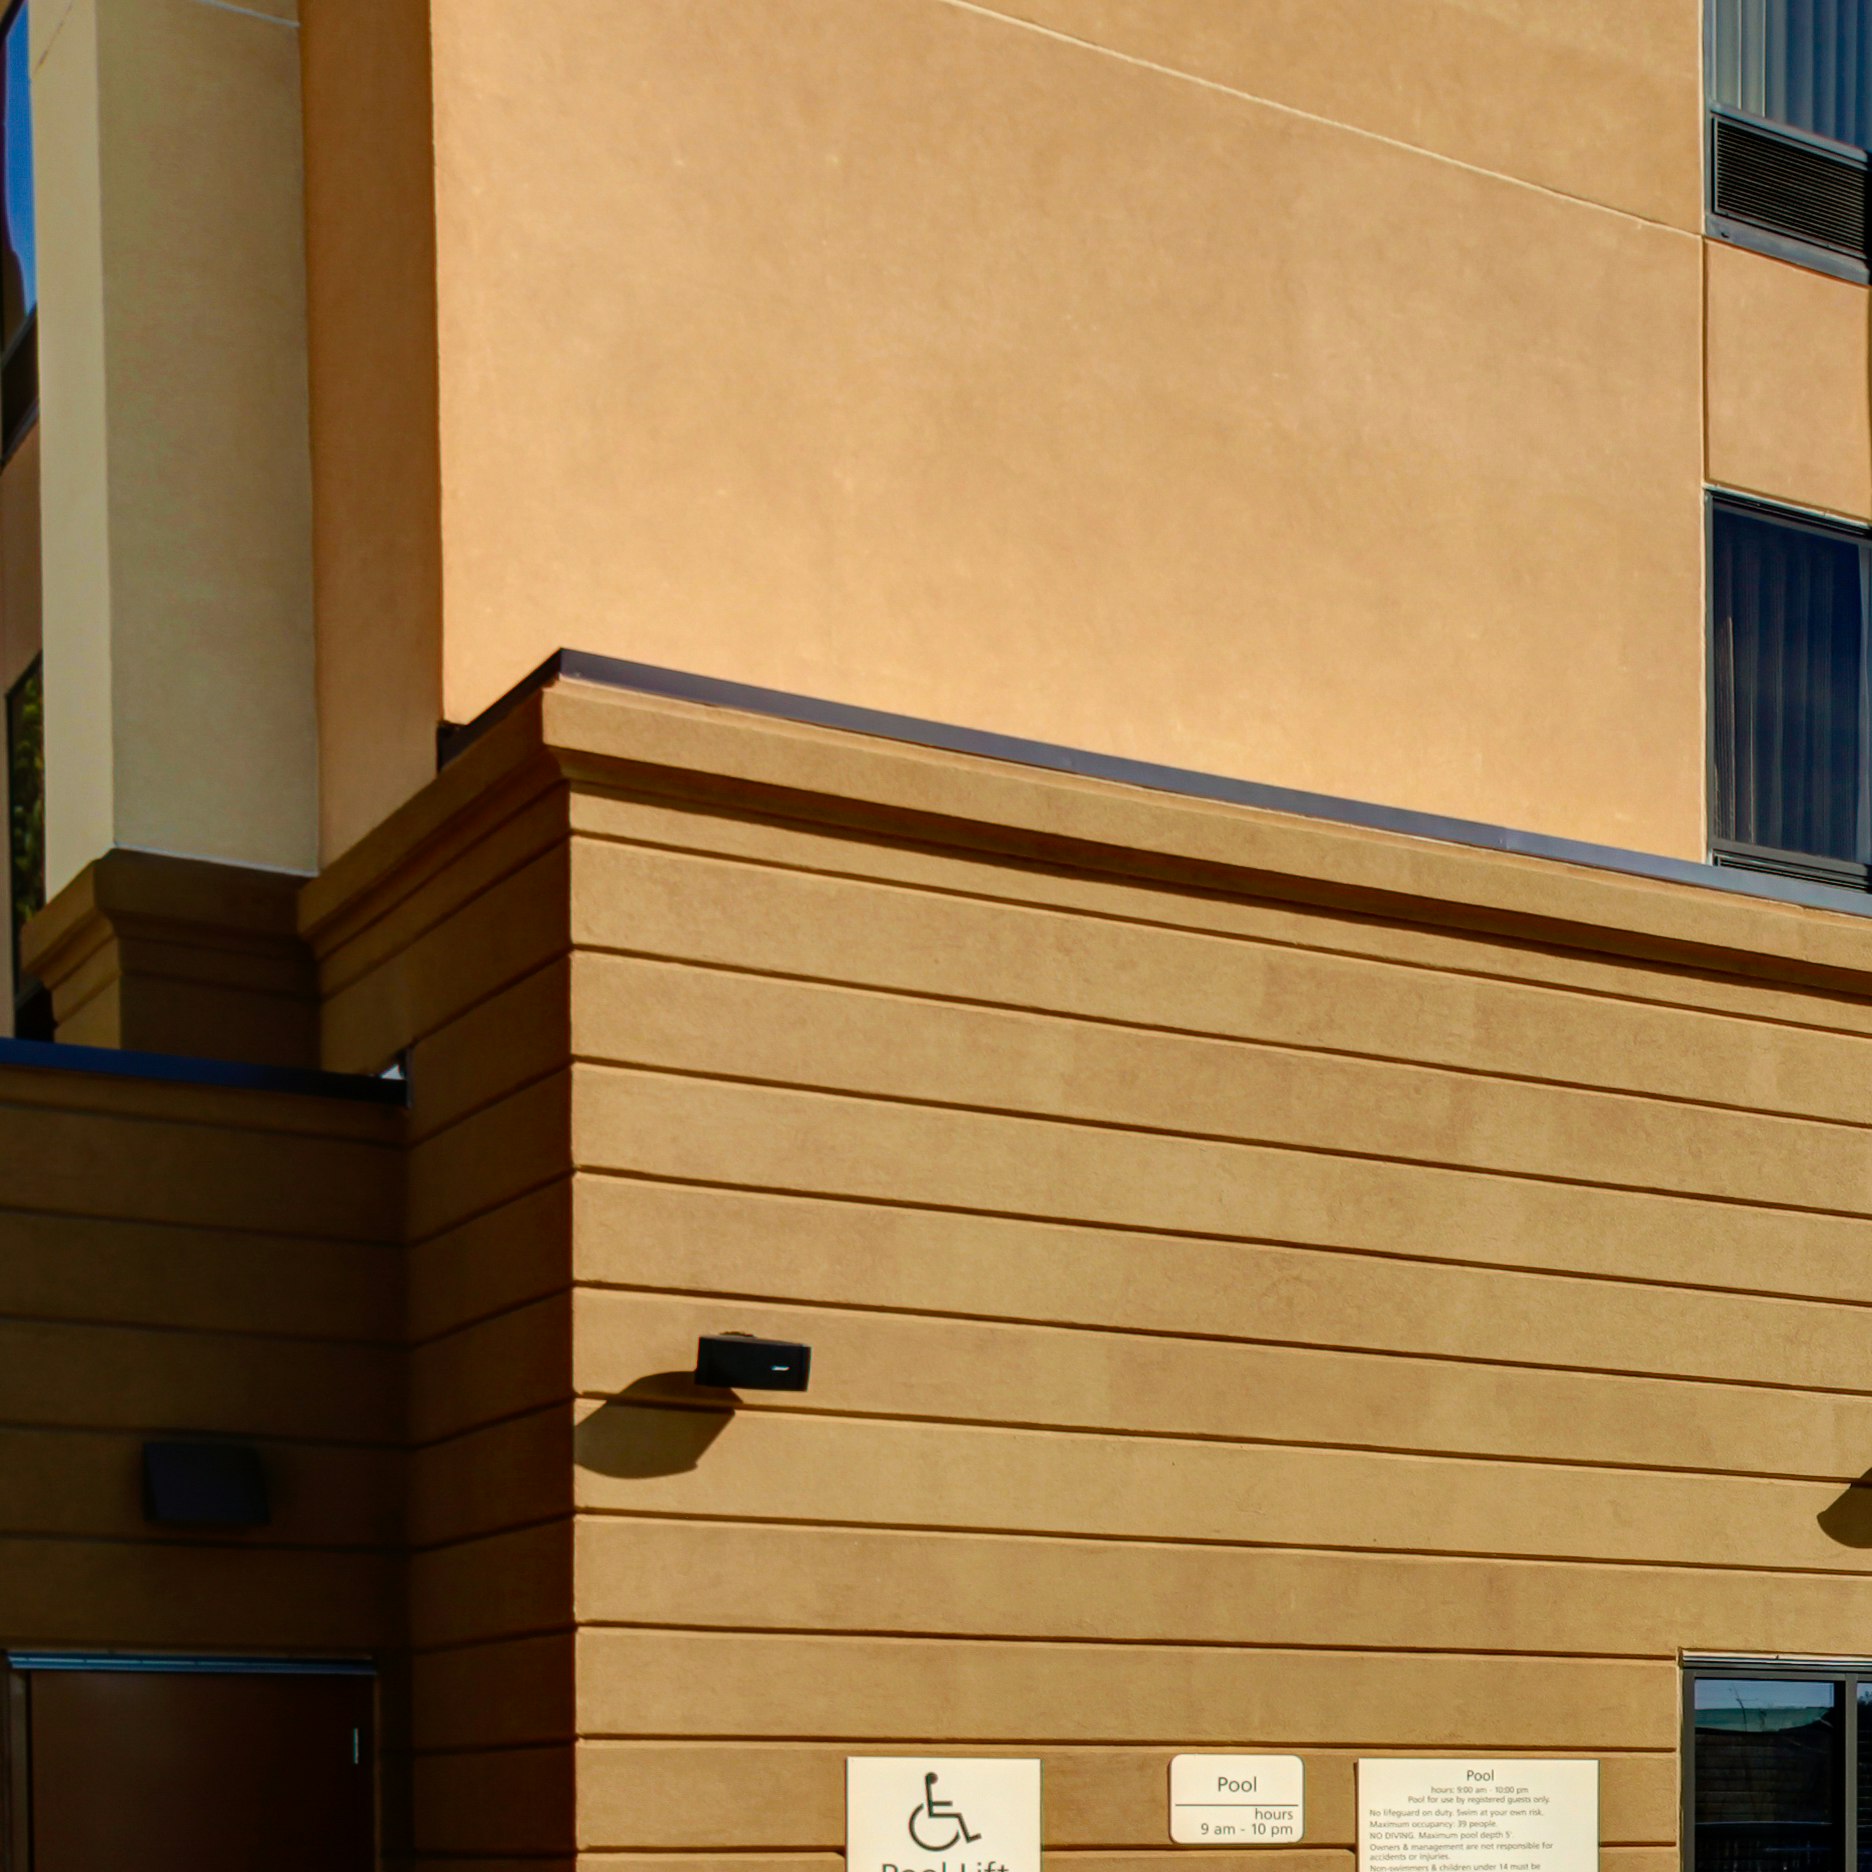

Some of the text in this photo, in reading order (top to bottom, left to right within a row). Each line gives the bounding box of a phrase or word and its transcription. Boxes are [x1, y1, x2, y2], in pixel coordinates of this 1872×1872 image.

[1467, 1770, 1494, 1781] Pool
[1217, 1775, 1257, 1793] Pool
[1456, 1796, 1465, 1804] by
[1468, 1796, 1504, 1804] registered
[1507, 1796, 1531, 1804] guests
[1254, 1807, 1293, 1821] hours
[1383, 1809, 1419, 1818] lifeguard
[1201, 1823, 1209, 1836] 9
[1214, 1826, 1236, 1836] am
[1252, 1823, 1266, 1835] 10
[1271, 1825, 1293, 1839] pm
[1460, 1832, 1478, 1840] pool
[1480, 1831, 1503, 1840] depth
[1496, 1842, 1539, 1850] responsible
